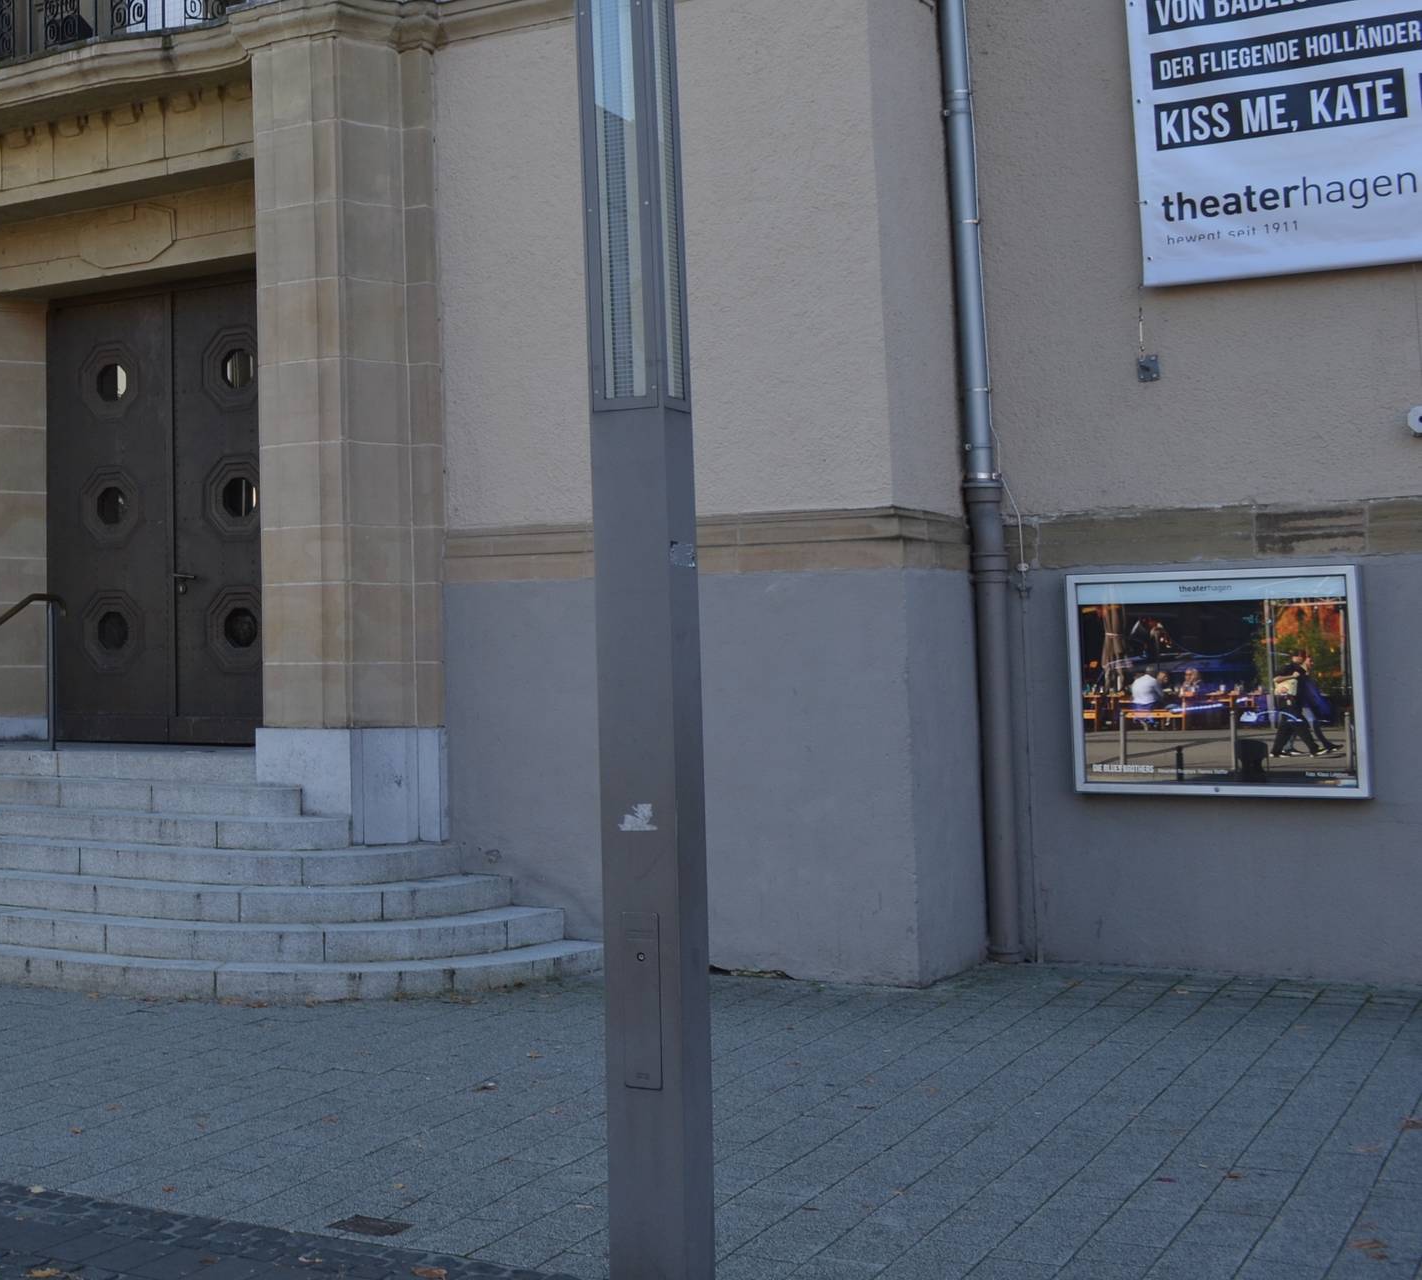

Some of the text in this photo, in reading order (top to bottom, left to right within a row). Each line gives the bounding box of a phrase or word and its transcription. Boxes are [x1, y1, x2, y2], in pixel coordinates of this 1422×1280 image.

[1159, 19, 1422, 81] DER FLIEGENDE HOLLÄNDER
[1160, 77, 1397, 145] KISS ME, KATE
[1162, 170, 1418, 223] theaterhagen
[1264, 220, 1298, 234] 1911
